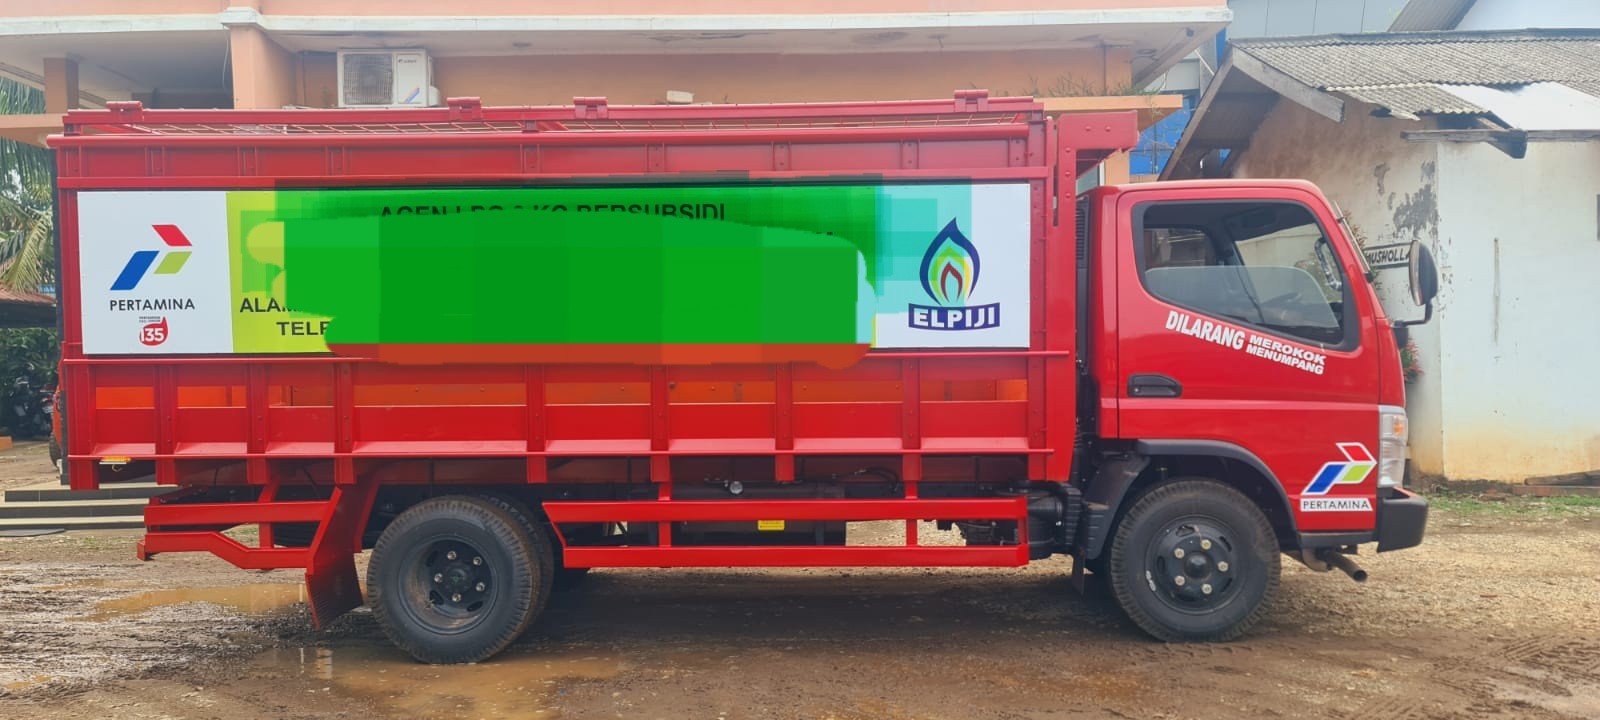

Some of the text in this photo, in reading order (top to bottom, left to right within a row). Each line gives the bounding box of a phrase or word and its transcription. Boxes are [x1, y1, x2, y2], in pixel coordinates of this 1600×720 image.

[1363, 247, 1410, 265] MUSHOLL
[109, 297, 196, 311] PERTAMINA
[239, 297, 298, 313] ALA
[913, 307, 996, 329] ELPIJI
[139, 326, 165, 342] 135
[1165, 310, 1327, 365] DILARANG MEROKOK
[1245, 343, 1325, 375] MENUMPANG
[1303, 500, 1370, 510] PERTAMINA
